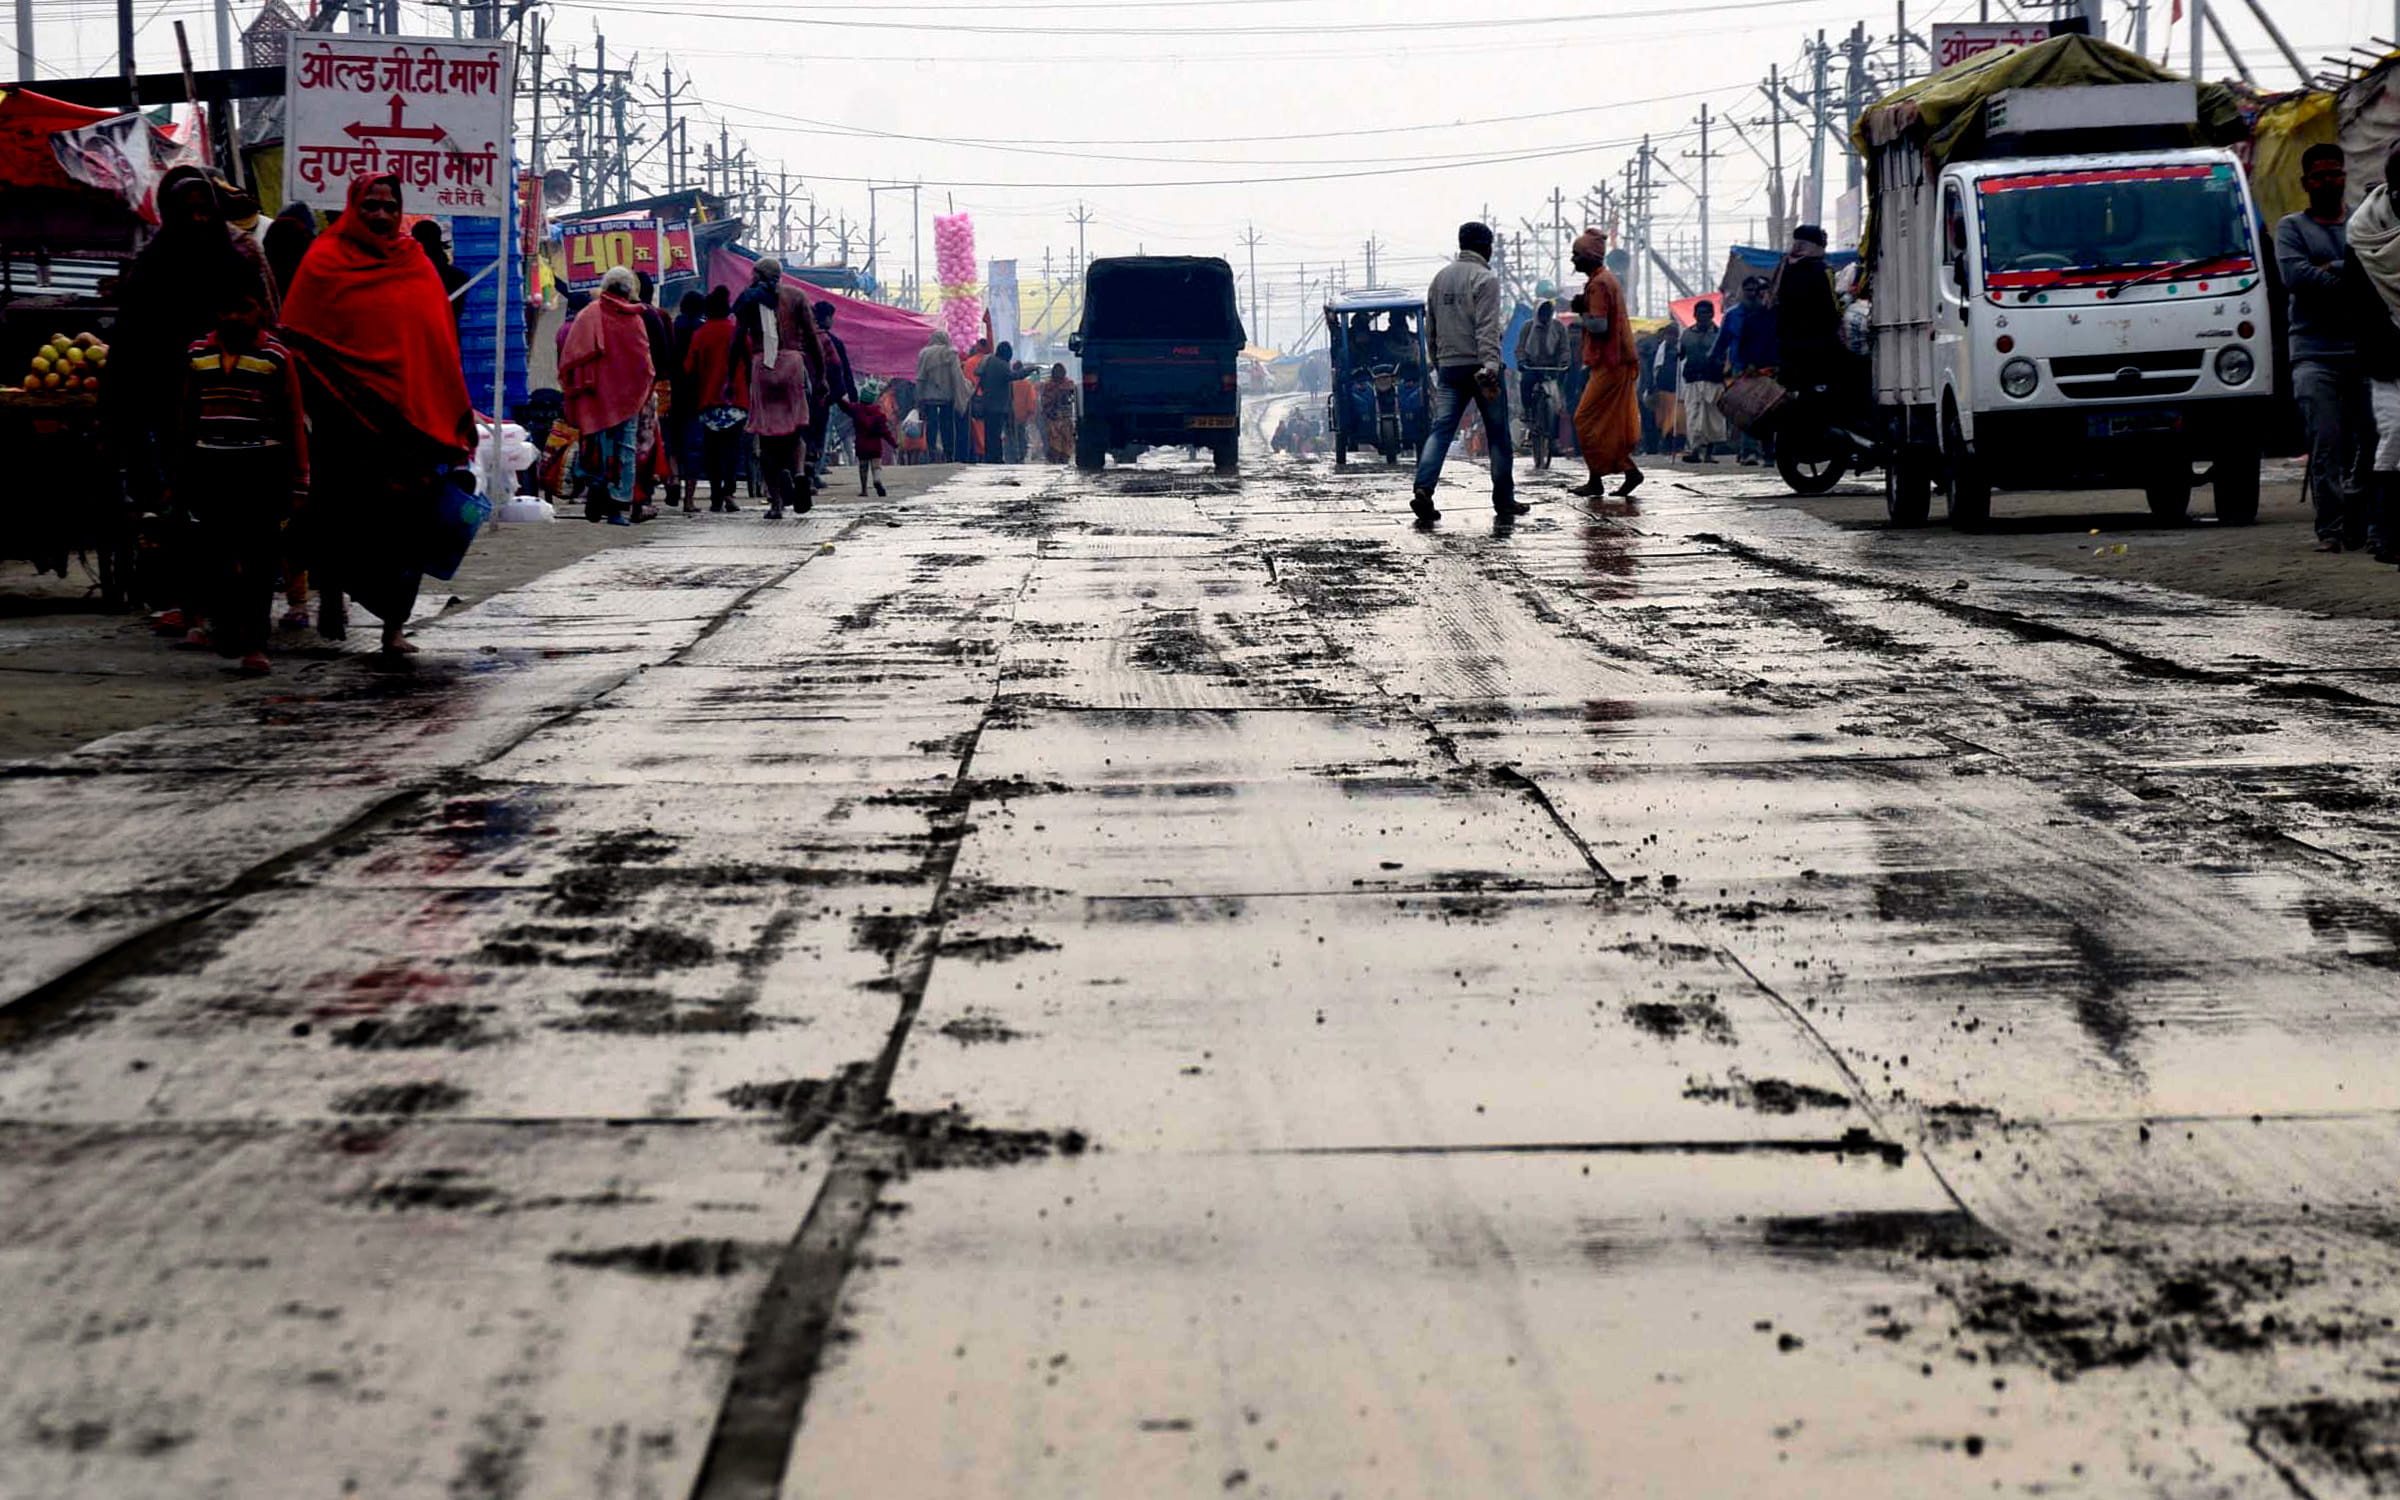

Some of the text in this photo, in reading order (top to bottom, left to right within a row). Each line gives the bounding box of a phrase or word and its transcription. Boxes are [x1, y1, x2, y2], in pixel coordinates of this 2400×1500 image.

[297, 42, 378, 93] ओल्ड
[447, 52, 500, 95] मार्ग
[298, 138, 381, 193] दण्डी
[443, 142, 498, 187] मार्ग
[573, 232, 634, 274] 40
